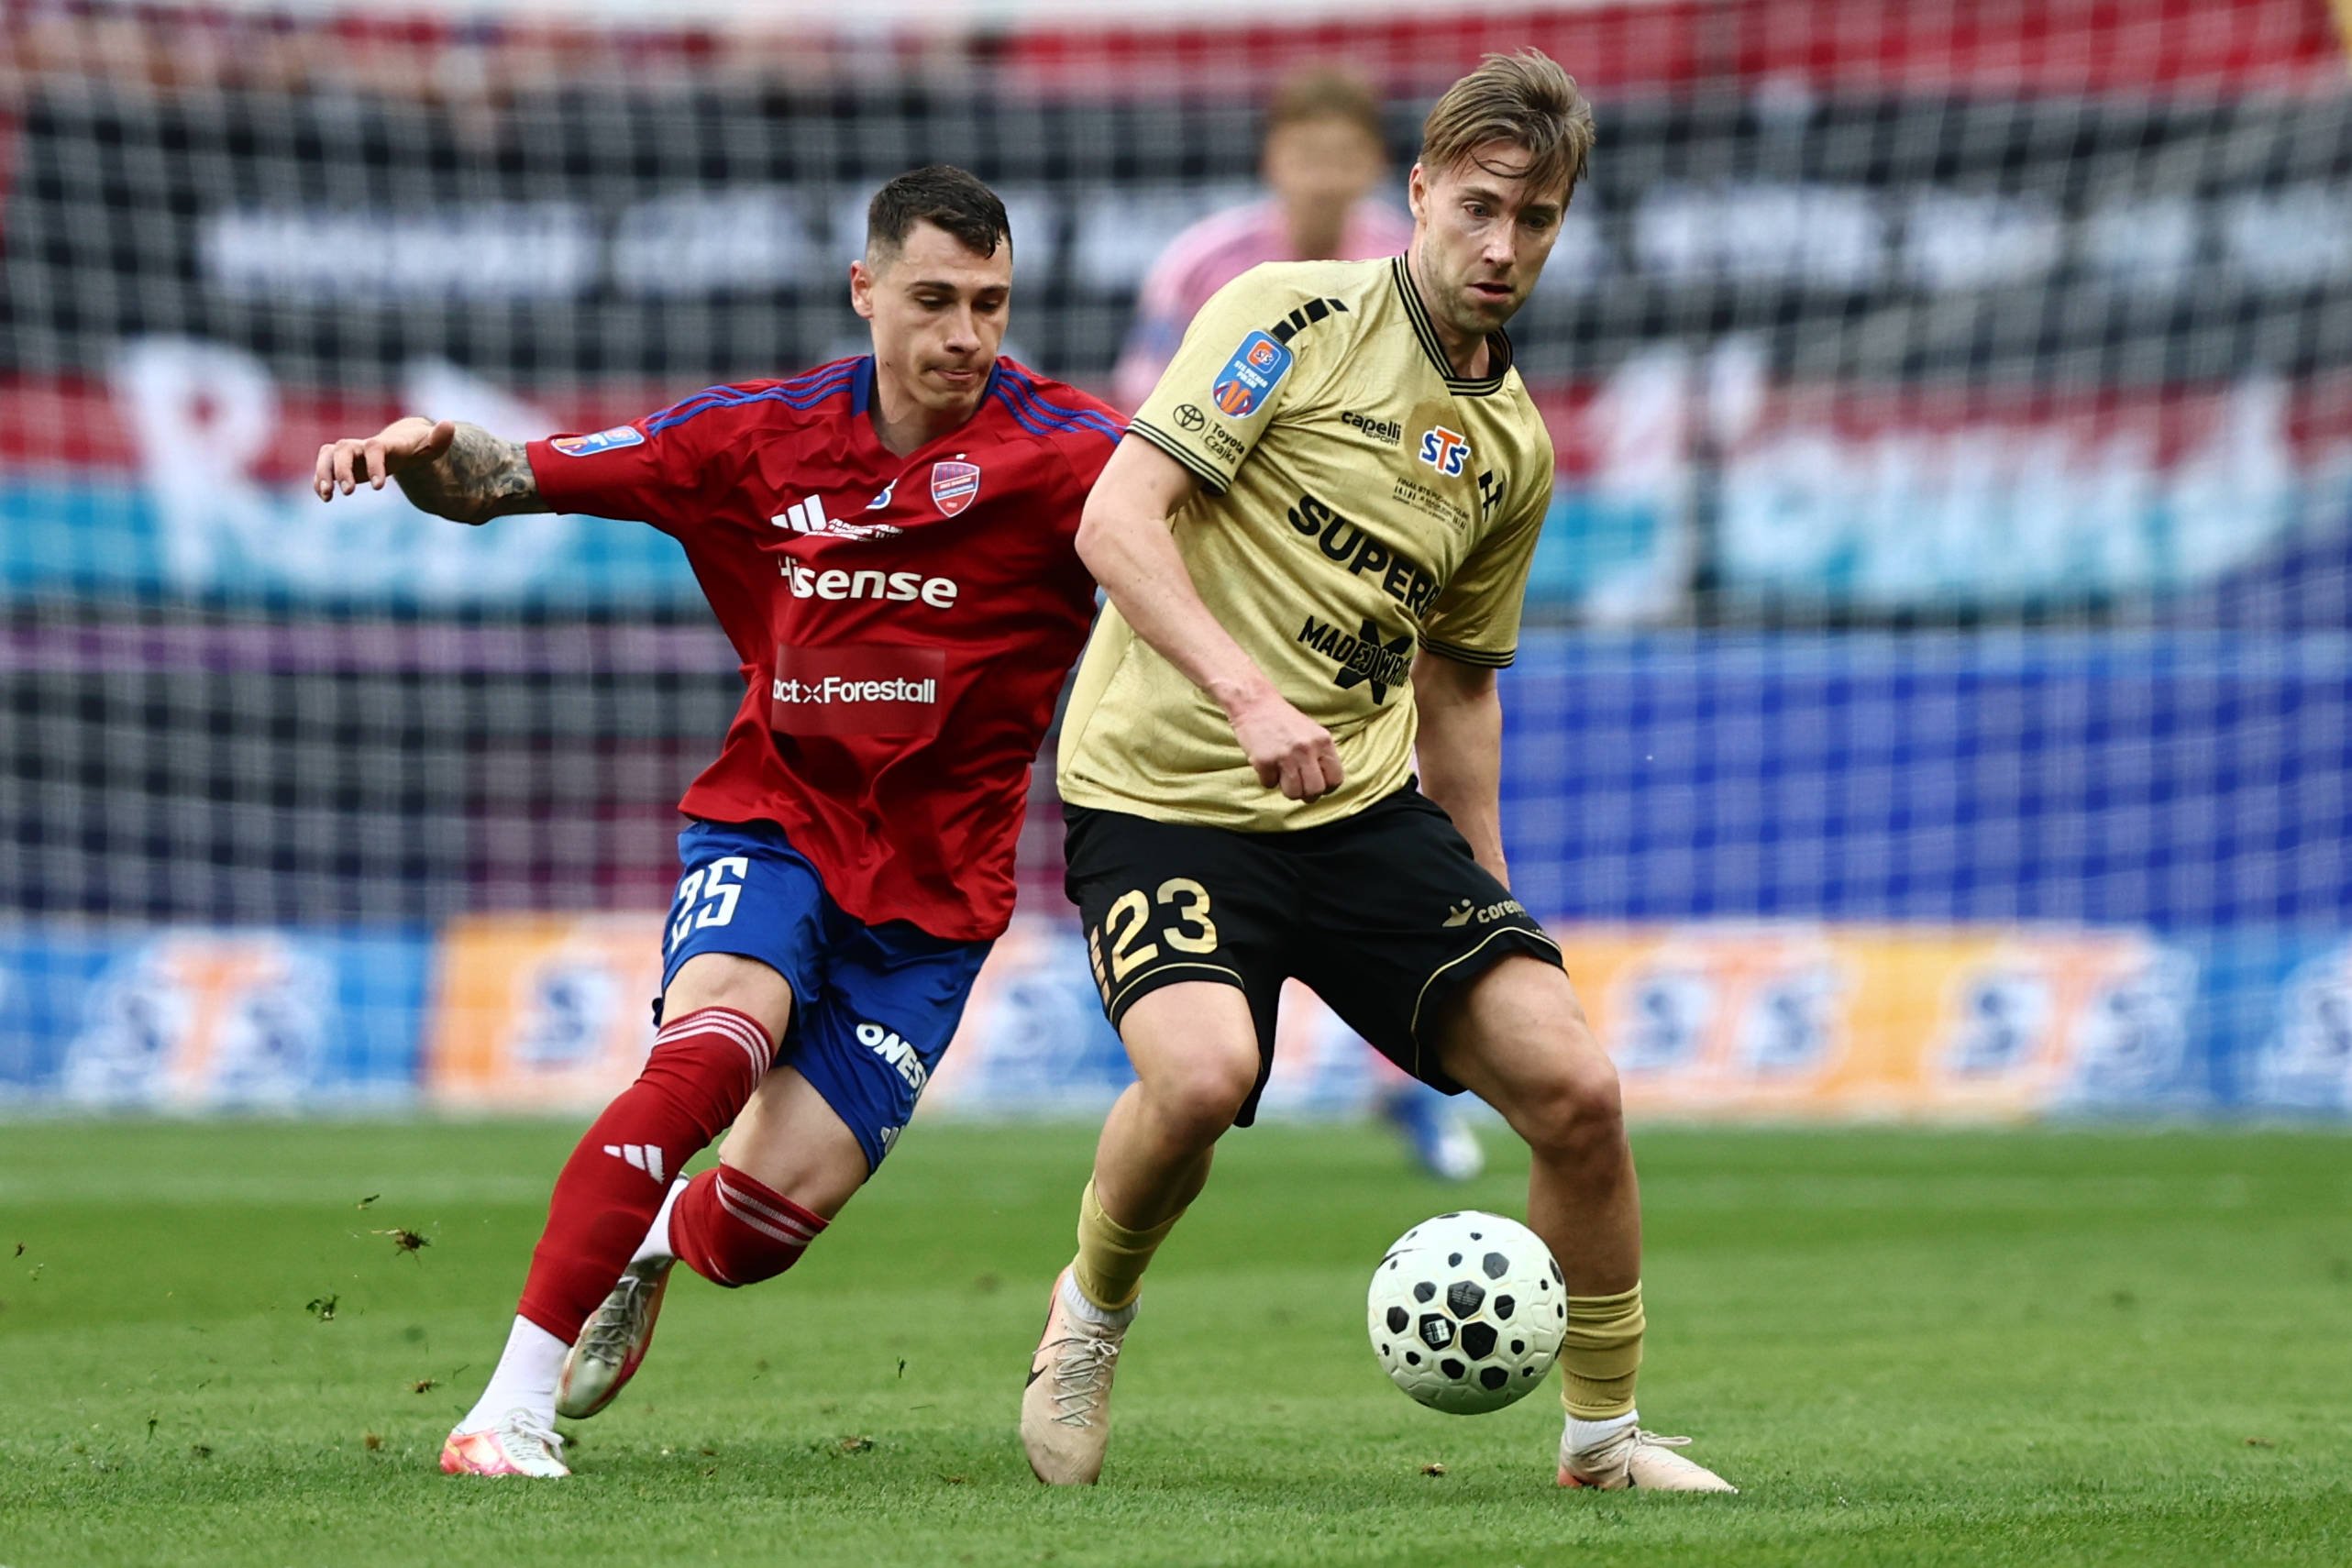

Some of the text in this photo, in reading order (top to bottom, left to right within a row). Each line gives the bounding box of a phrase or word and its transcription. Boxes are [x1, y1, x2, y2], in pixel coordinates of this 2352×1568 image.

[1212, 422, 1245, 455] Toyota
[1342, 412, 1401, 440] capelli
[1366, 432, 1400, 447] SPORT
[1204, 436, 1237, 465] Czajka
[1419, 425, 1470, 477] STS
[1297, 615, 1378, 676] MADEJ
[823, 677, 935, 704] Forestall
[670, 856, 749, 954] 25
[1106, 877, 1218, 983] 23
